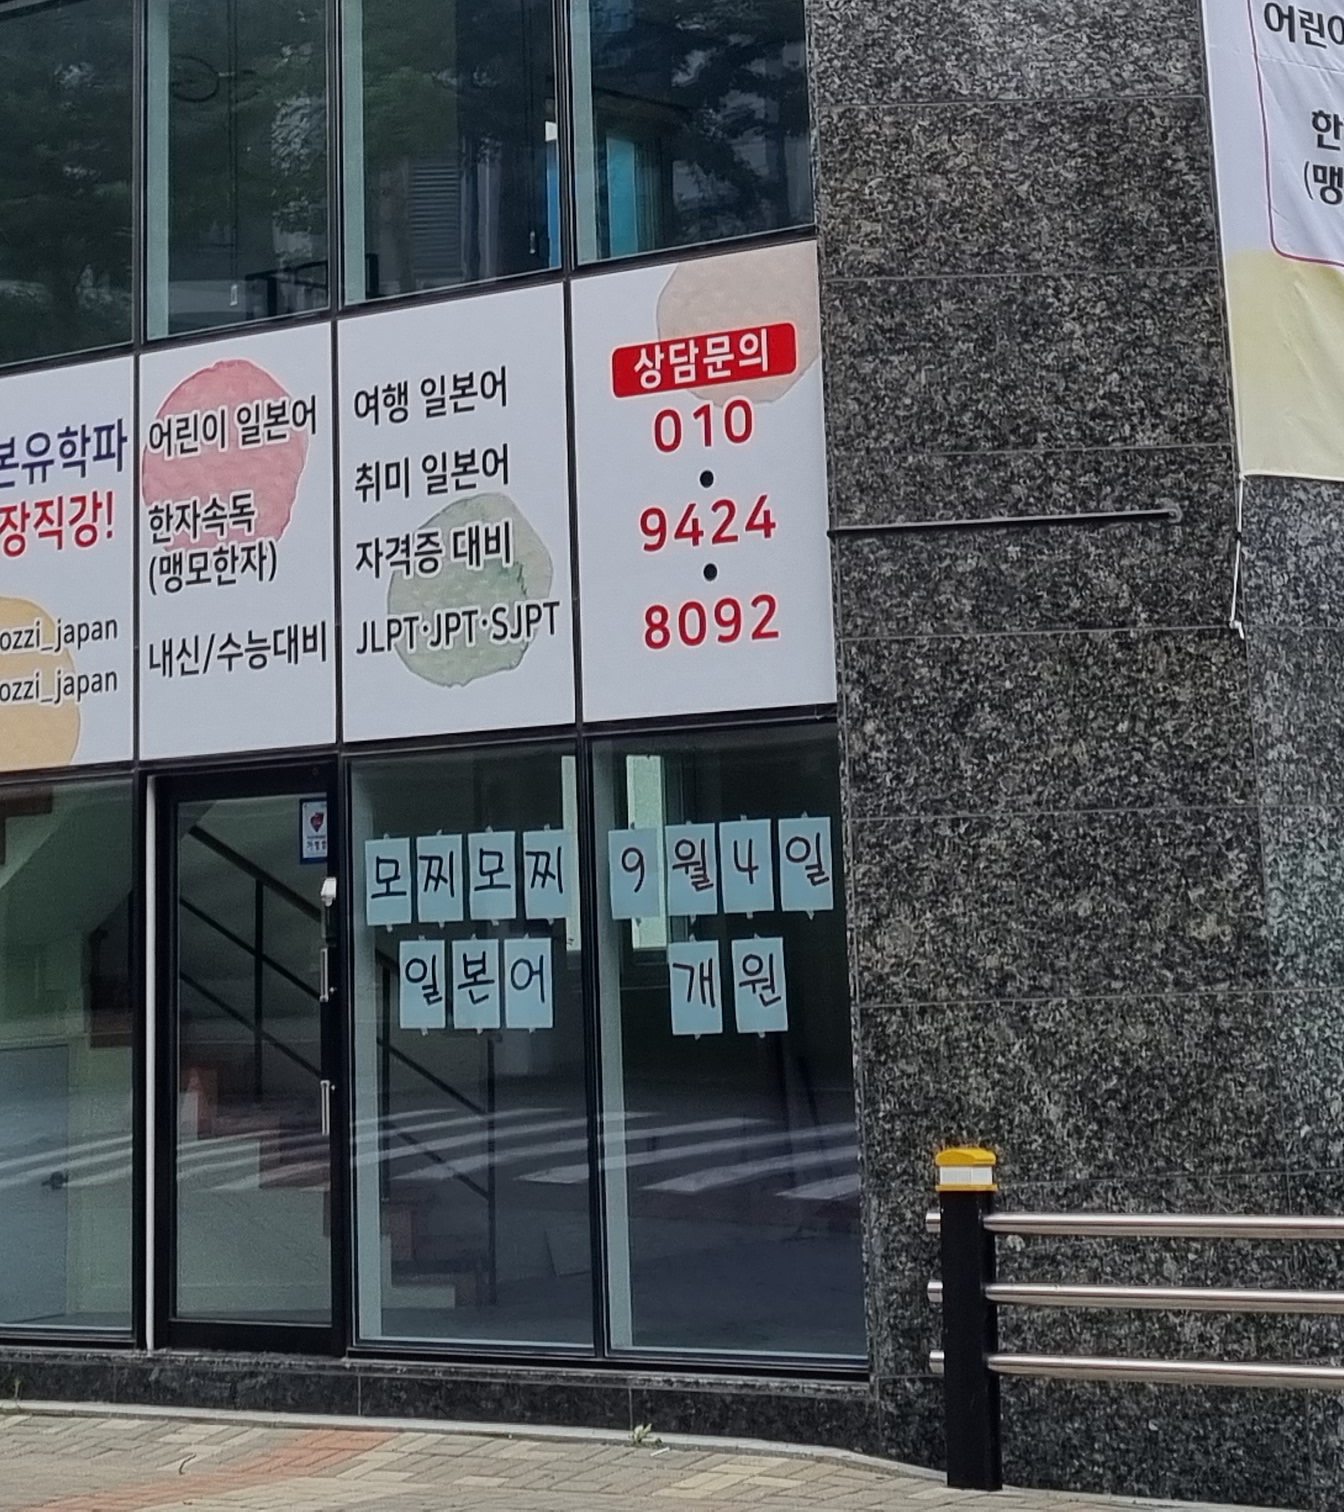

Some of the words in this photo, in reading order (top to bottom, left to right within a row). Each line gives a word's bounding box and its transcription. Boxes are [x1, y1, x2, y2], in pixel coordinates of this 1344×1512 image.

[634, 327, 770, 390] 상담문의
[354, 380, 410, 426] 여행
[419, 365, 509, 419] 일본어
[148, 410, 227, 460] 어린이
[235, 394, 318, 447] 일본어
[652, 398, 754, 453] 010
[354, 456, 411, 503] 취미
[421, 444, 510, 495] 일본어
[148, 493, 256, 546] 한자속독
[639, 494, 777, 553] 9424
[148, 540, 279, 596] (맹모한자)
[355, 531, 443, 579] 자격증
[452, 521, 513, 570] 대비
[148, 620, 328, 679] 내신/수능대비
[643, 594, 780, 650] 8092
[370, 847, 564, 900] 모찌모찌
[404, 950, 546, 1006] 일본어
[672, 952, 781, 1009] 개원
